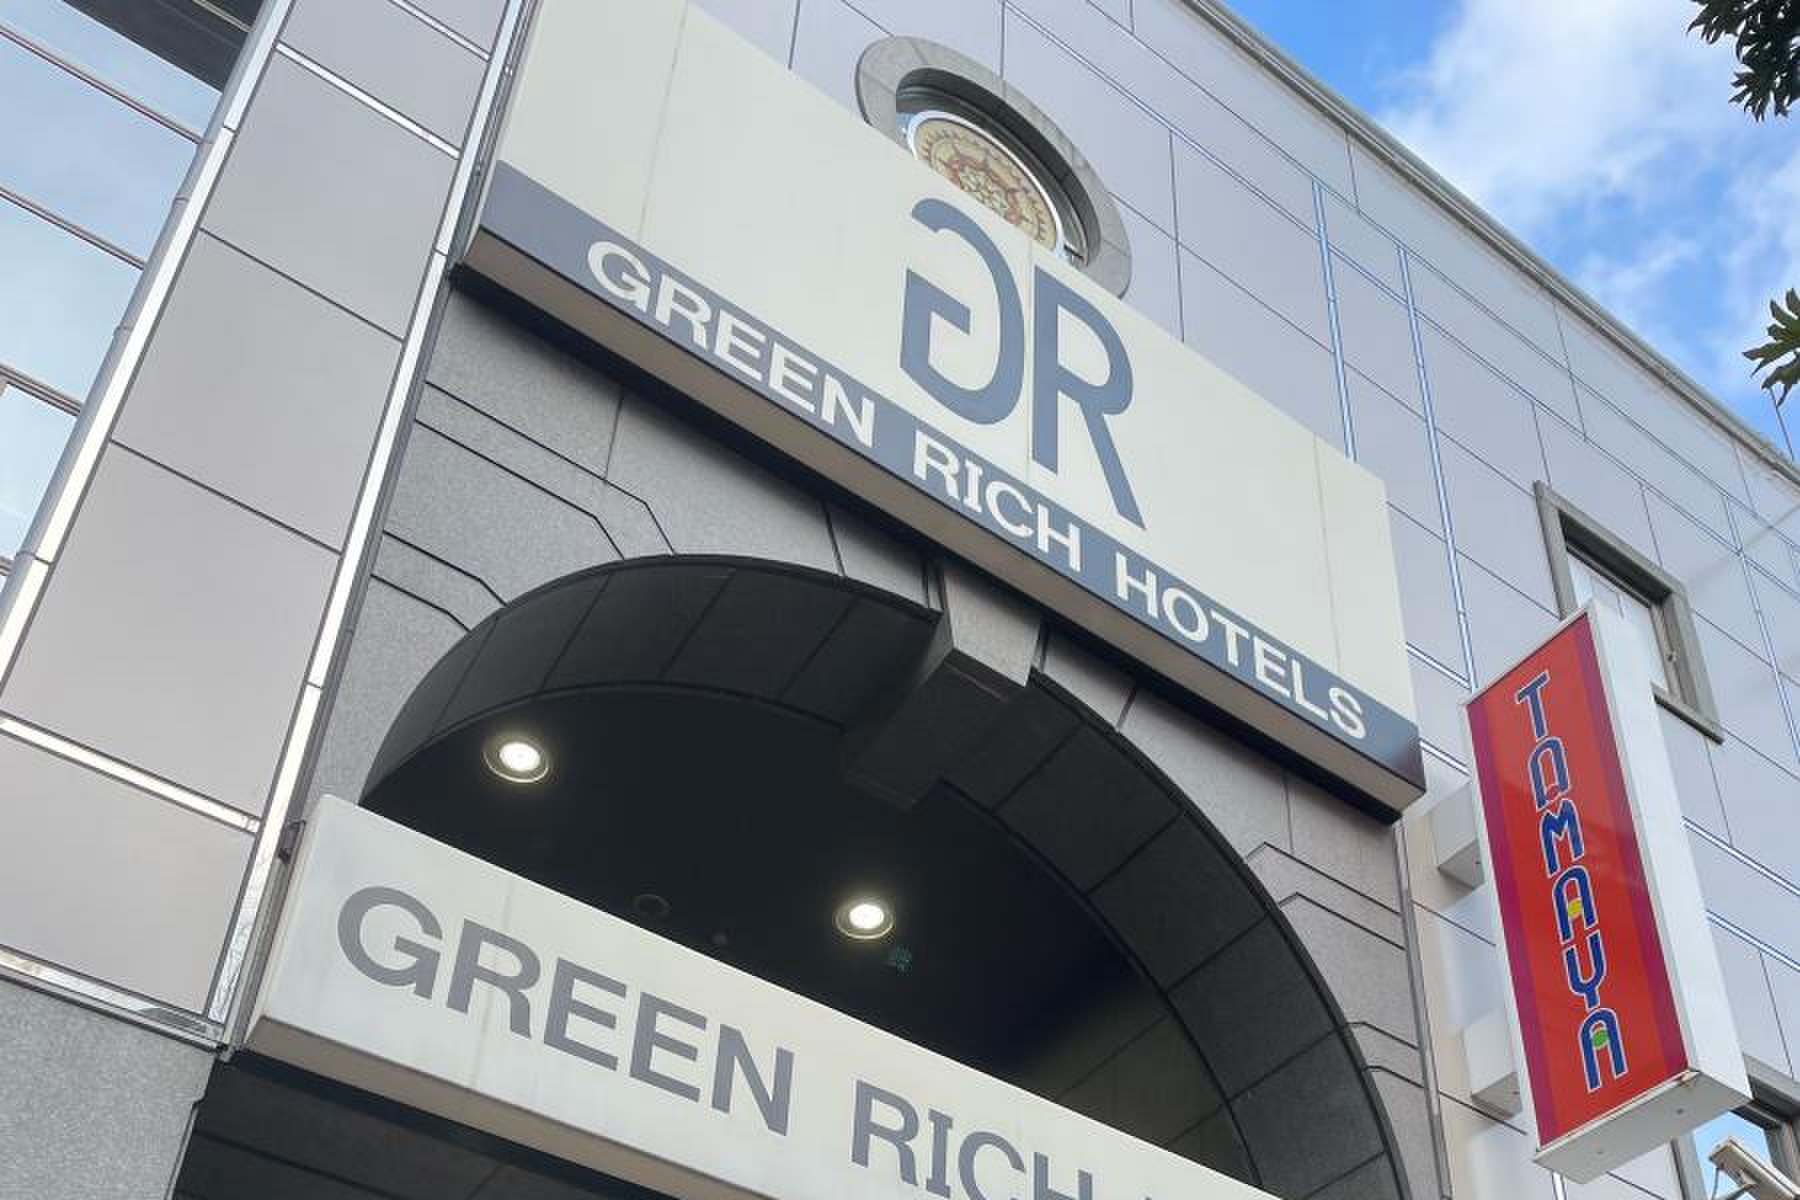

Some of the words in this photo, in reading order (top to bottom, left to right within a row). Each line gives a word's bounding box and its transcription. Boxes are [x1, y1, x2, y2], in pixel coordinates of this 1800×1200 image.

[587, 239, 875, 448] GREEN
[913, 430, 1082, 576] RICH
[1117, 566, 1367, 741] HOTELS
[337, 884, 795, 1137] GREEN
[1516, 669, 1630, 1092] TAMAYA
